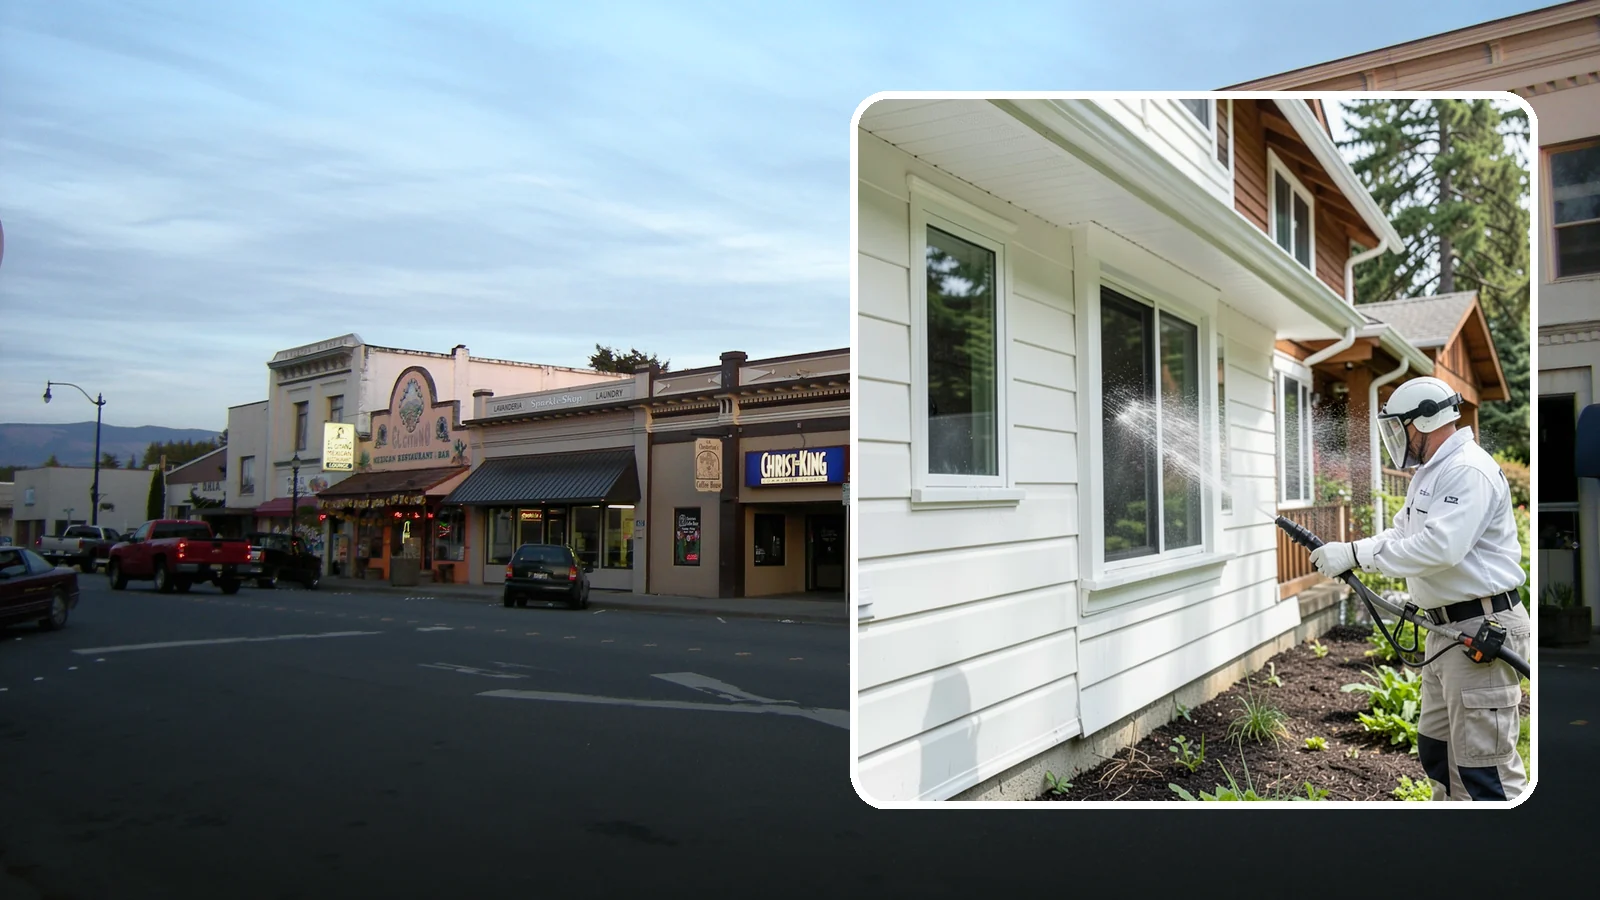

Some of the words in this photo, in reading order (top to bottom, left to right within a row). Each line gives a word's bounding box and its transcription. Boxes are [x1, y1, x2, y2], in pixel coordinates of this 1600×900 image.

[595, 388, 624, 400] LAUNDRY
[493, 401, 522, 413] LAVANDERIA
[530, 397, 560, 409] Sparkle
[561, 395, 582, 406] Shop
[374, 454, 396, 464] MEXICAN
[397, 451, 433, 462] RESTAURANT
[438, 450, 450, 459] BAR
